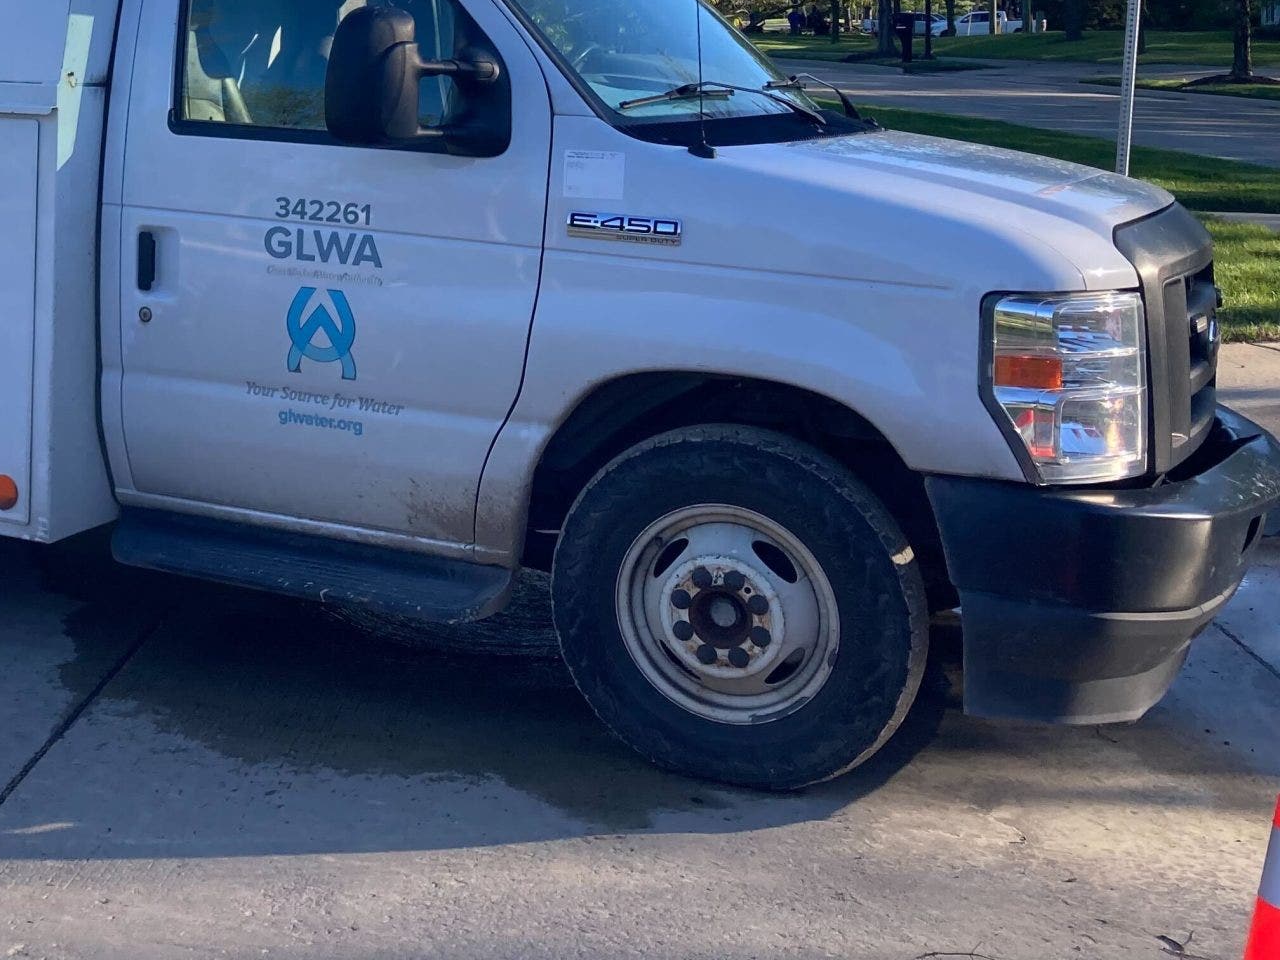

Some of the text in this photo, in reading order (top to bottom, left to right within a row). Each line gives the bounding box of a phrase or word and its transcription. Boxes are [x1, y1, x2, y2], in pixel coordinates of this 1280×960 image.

[275, 196, 371, 226] 342261
[264, 225, 383, 269] GLWA
[245, 381, 405, 417] Your Source for Water
[278, 408, 363, 435] glwater.org
